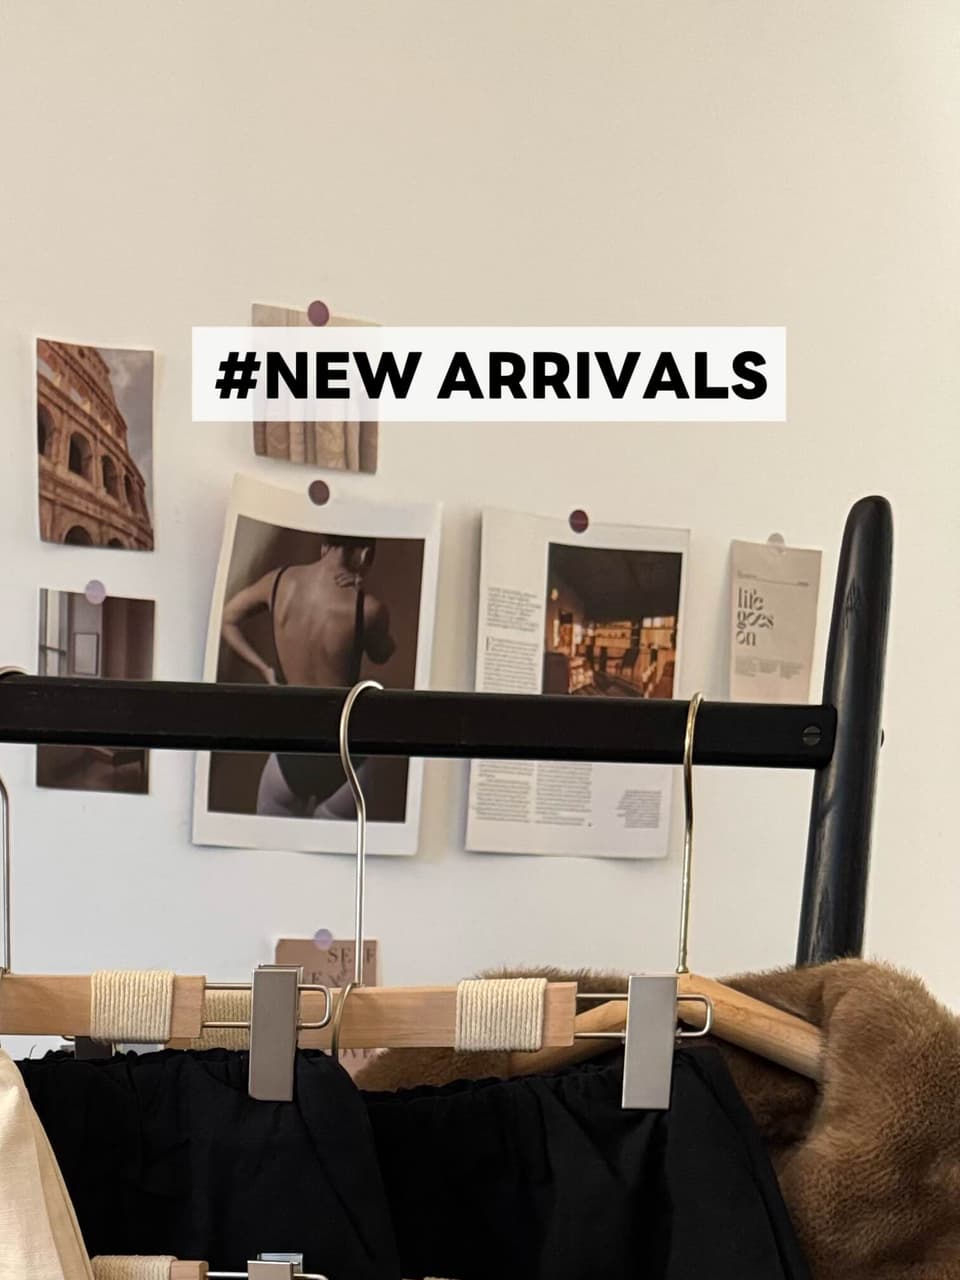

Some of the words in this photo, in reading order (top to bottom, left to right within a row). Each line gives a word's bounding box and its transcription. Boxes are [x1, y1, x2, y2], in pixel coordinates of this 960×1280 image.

[737, 587, 764, 611] life
[737, 611, 775, 629] goes
[736, 631, 756, 646] on
